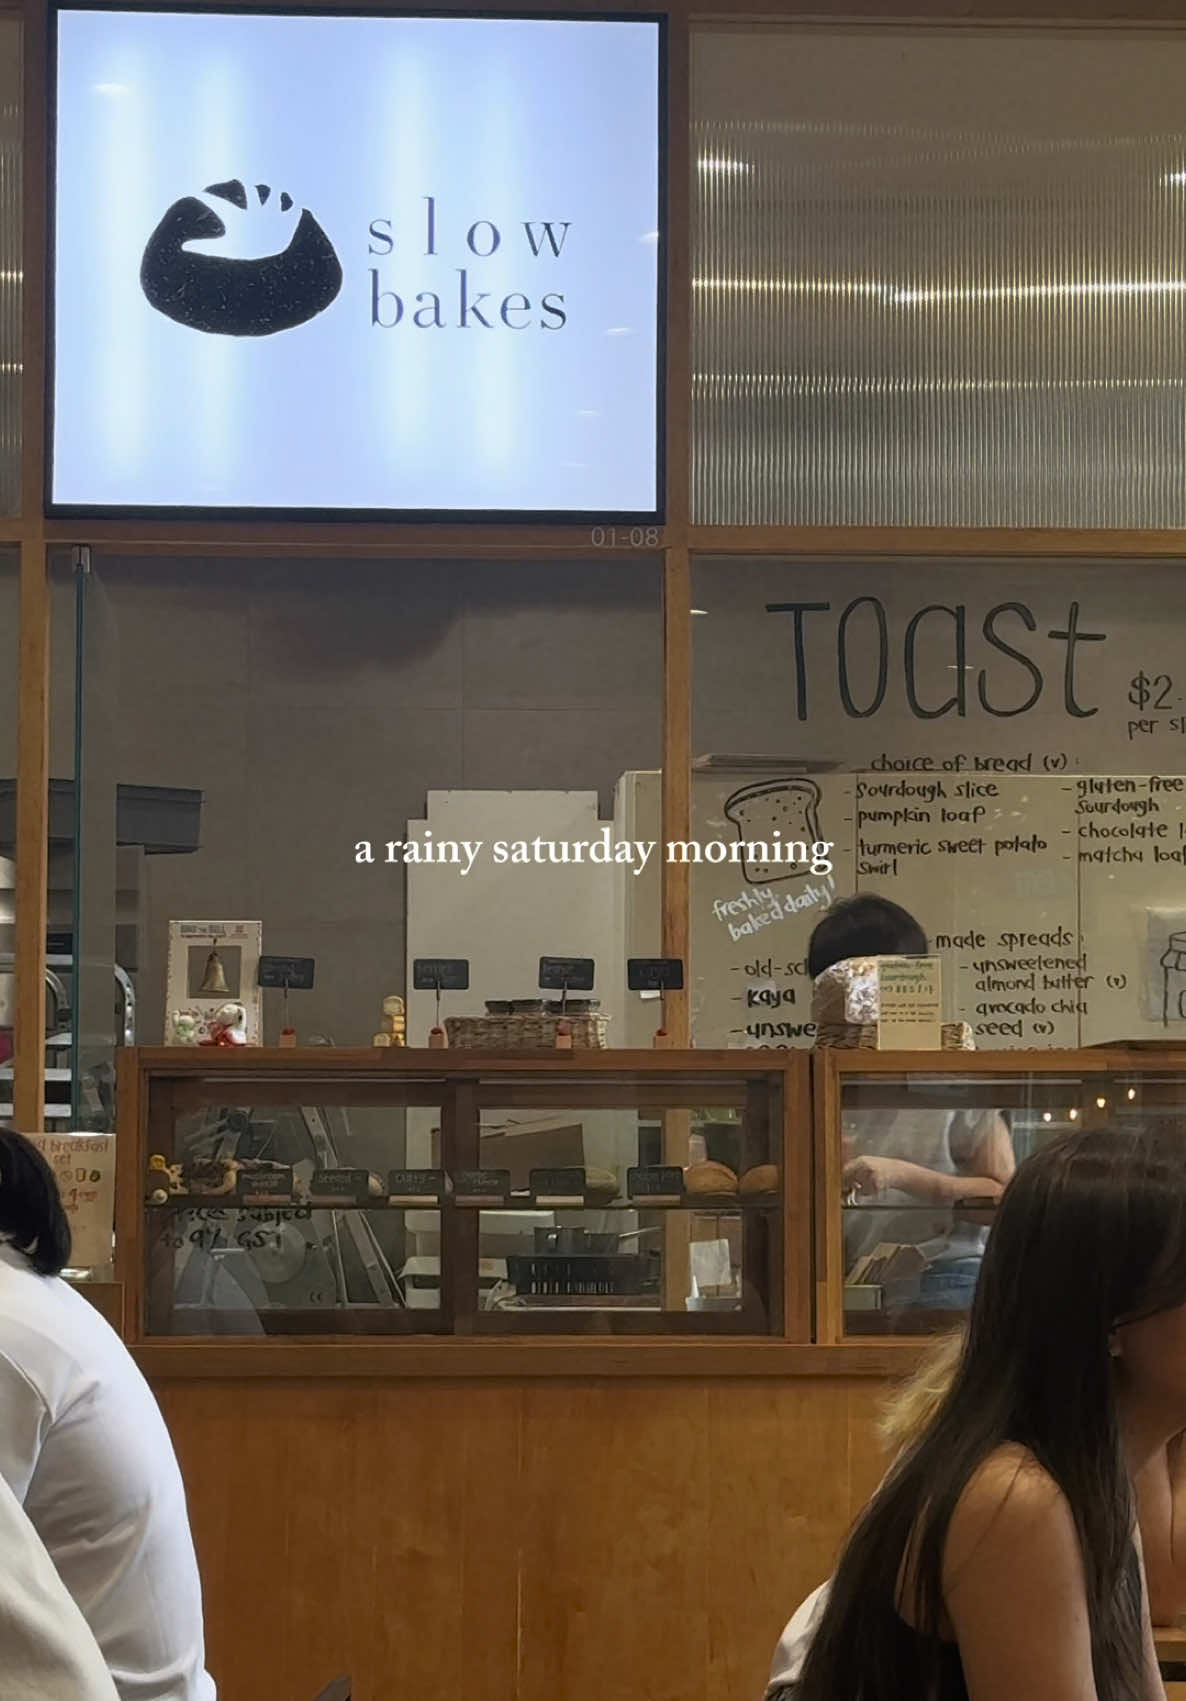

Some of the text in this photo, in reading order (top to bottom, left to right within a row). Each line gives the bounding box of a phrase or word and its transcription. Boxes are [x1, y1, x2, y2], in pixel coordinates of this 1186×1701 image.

[367, 196, 572, 258] slow
[370, 267, 568, 331] bakes
[591, 526, 659, 548] 01-08
[1128, 718, 1160, 741] per
[871, 753, 934, 772] choice
[943, 753, 967, 772] of
[974, 752, 1033, 772] bread
[953, 780, 999, 798] slice
[1076, 775, 1185, 799] gluten-free
[858, 807, 931, 829] pumpkin
[1078, 821, 1169, 840] chocolate
[857, 834, 1048, 857] turmeric sweet potato
[1078, 846, 1144, 864] matcha
[711, 887, 775, 922] freshly
[727, 900, 784, 942] baked
[972, 953, 1087, 974] unsweetened
[975, 972, 1036, 992] almond
[1043, 973, 1095, 990] butter
[747, 988, 796, 1009] kaya
[975, 997, 1088, 1017] avocado chia
[974, 1019, 1023, 1038] seed
